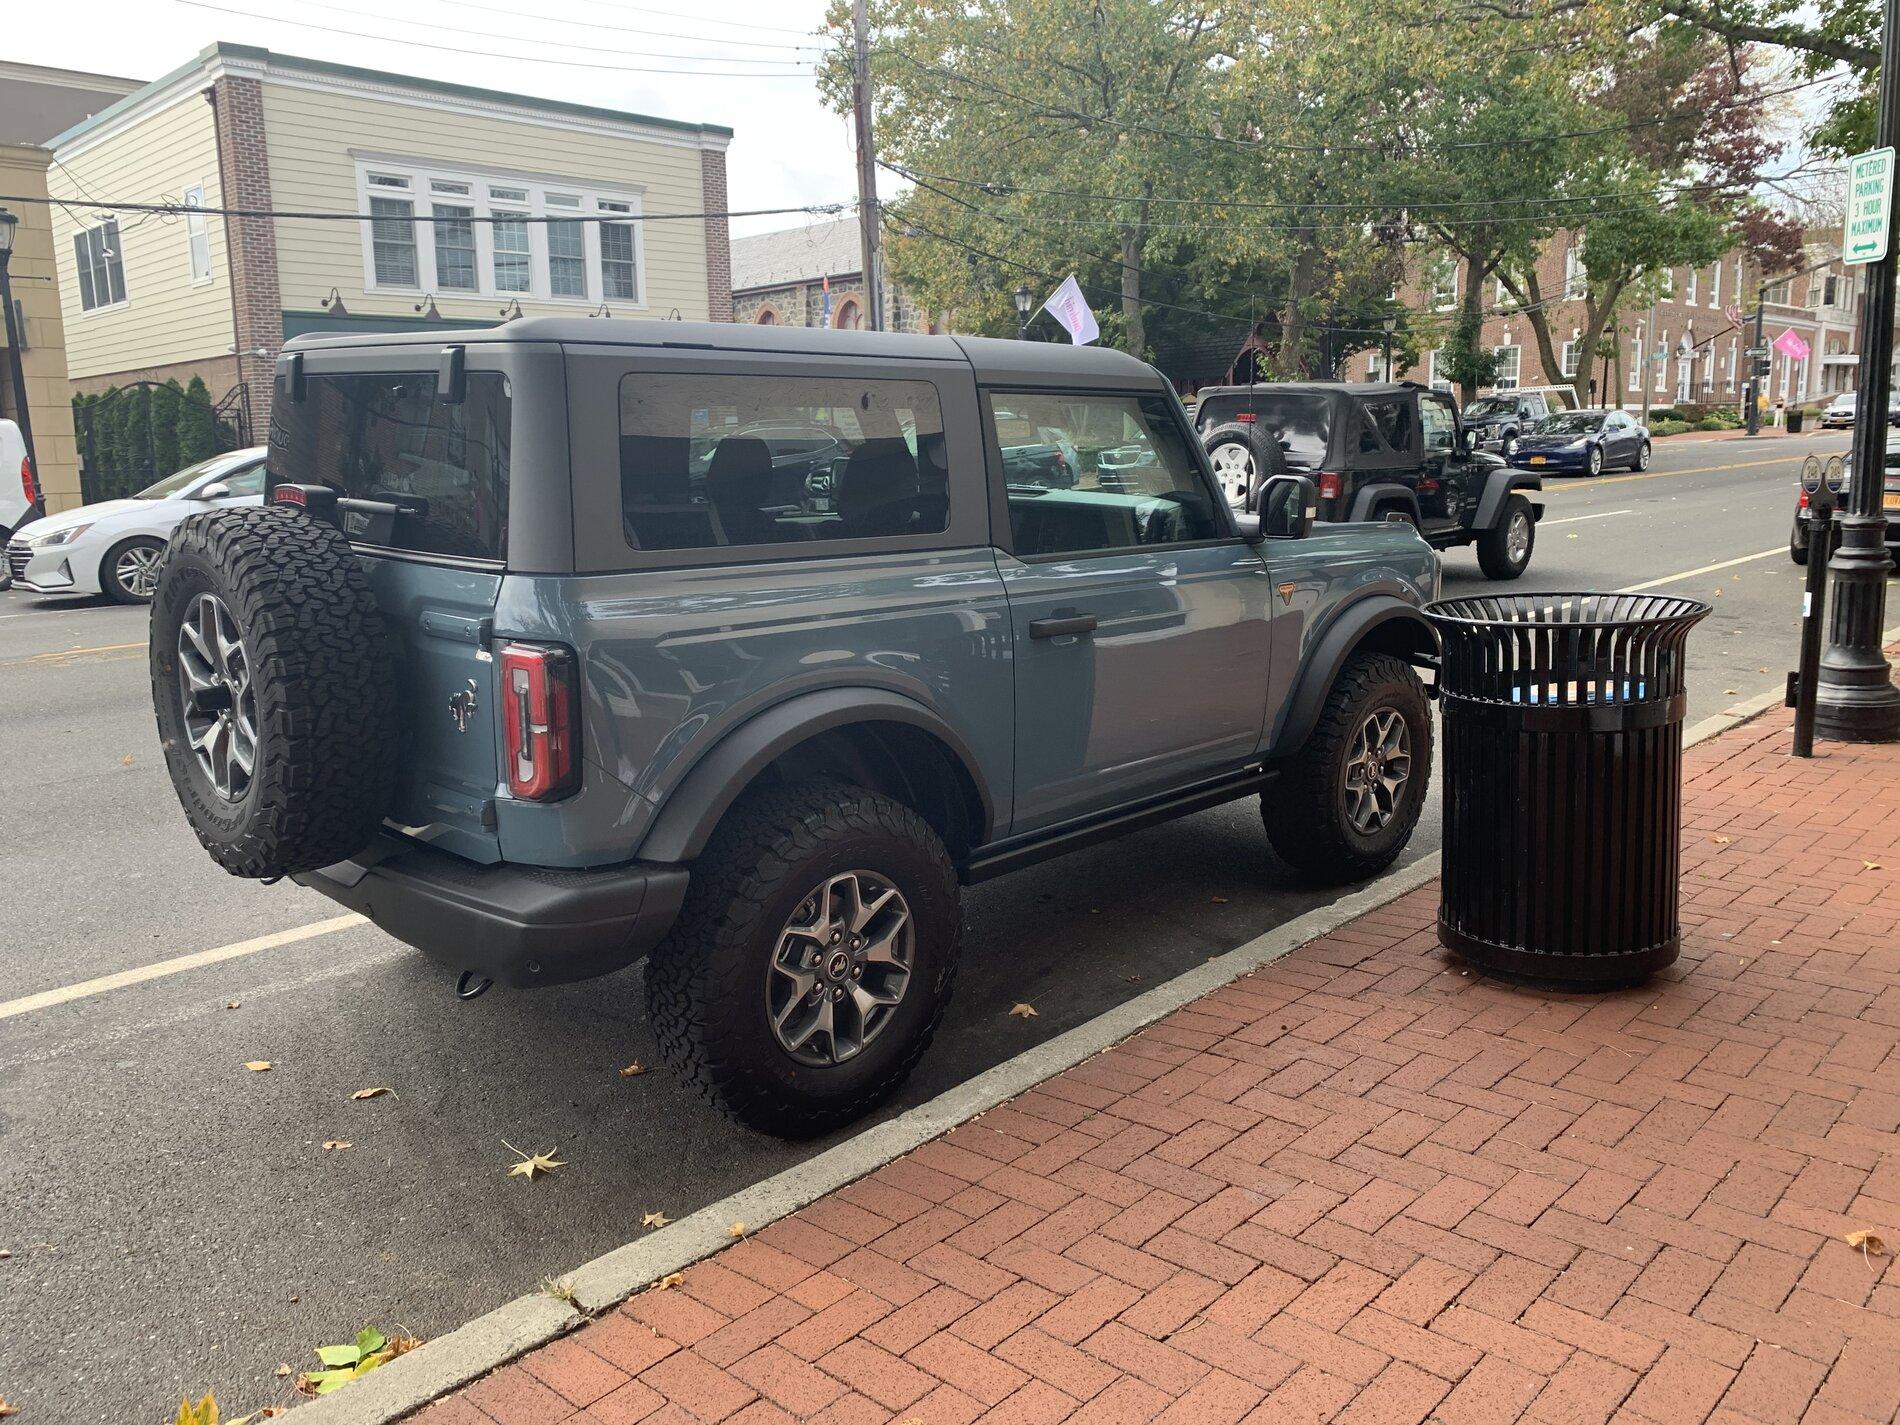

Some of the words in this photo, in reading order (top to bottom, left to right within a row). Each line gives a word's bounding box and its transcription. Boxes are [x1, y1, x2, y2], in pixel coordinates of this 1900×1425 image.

[1856, 159, 1886, 179] METERED
[1855, 178, 1884, 197] PARKING
[1855, 203, 1859, 217] 3
[1864, 199, 1881, 216] HOUR
[1851, 218, 1882, 236] MAXIMUM
